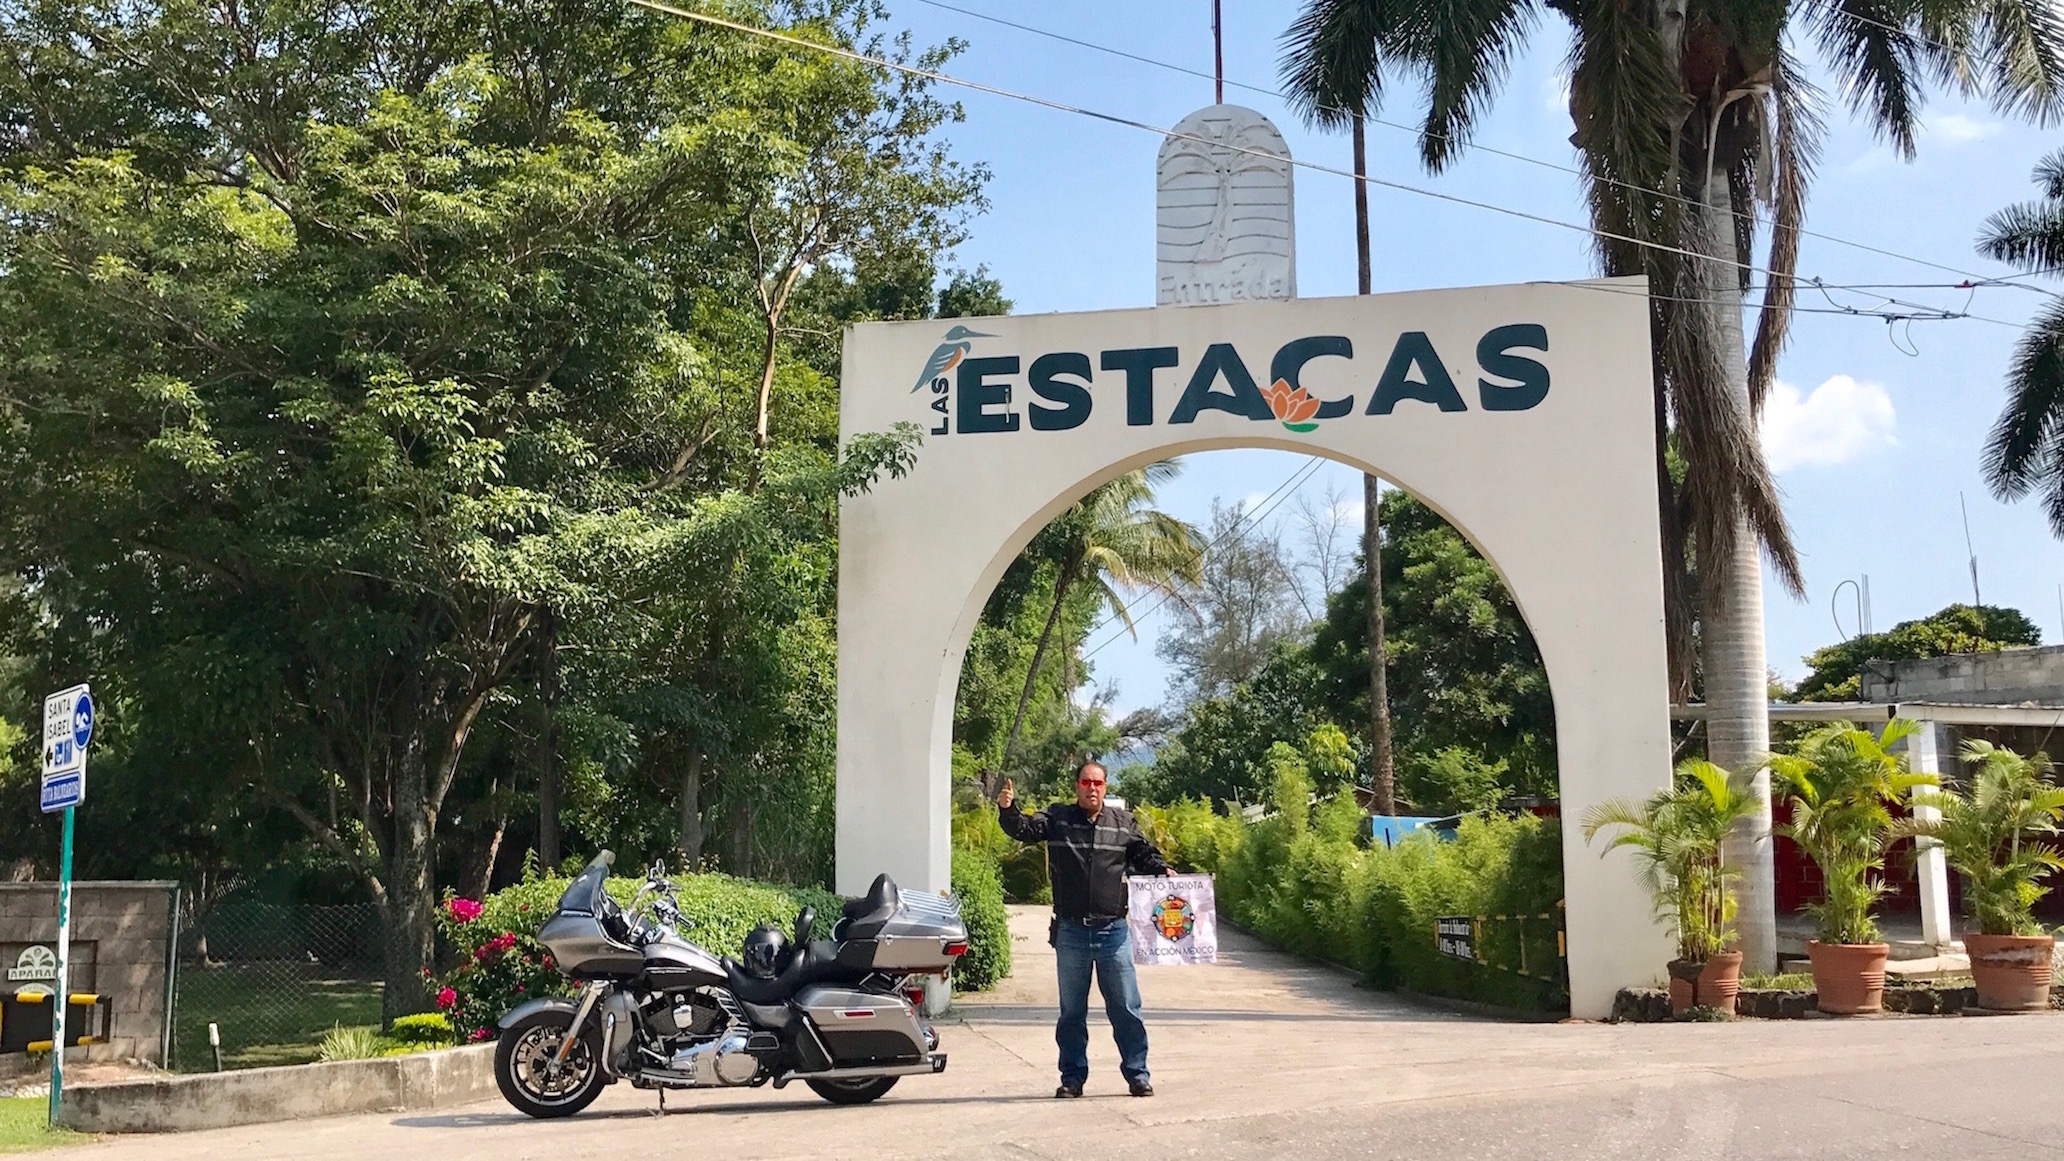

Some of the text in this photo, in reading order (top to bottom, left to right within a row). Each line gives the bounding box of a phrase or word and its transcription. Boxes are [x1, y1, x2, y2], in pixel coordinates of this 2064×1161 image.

[1158, 270, 1291, 305] Entrada
[931, 324, 1551, 435] LAS ESTACAS
[48, 698, 71, 719] SANTA
[46, 719, 71, 740] ISABEL
[1135, 880, 1204, 891] MOTO TURISTA
[1136, 948, 1147, 957] EN
[1149, 945, 1182, 956] ACCIÓN
